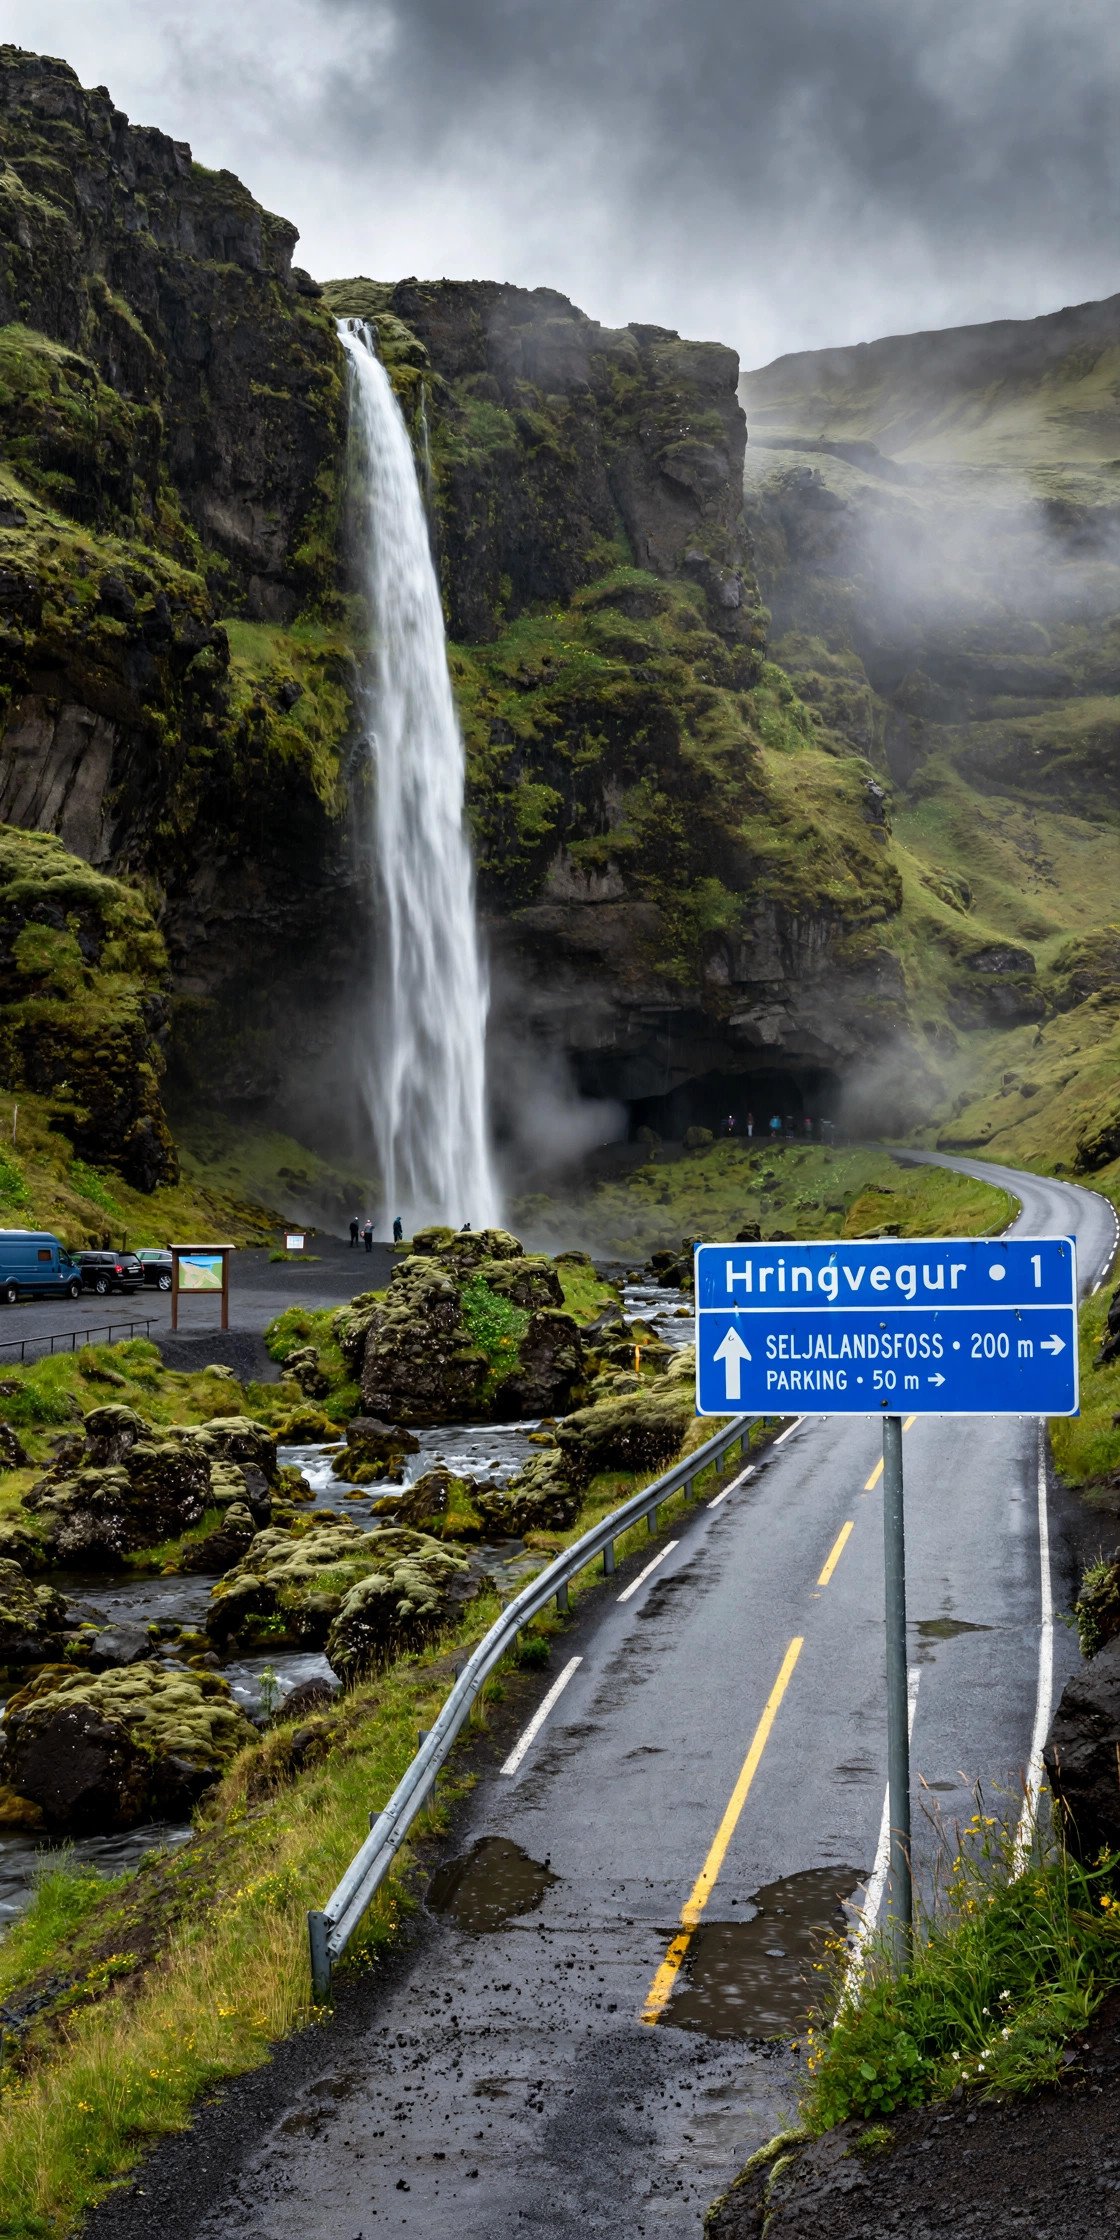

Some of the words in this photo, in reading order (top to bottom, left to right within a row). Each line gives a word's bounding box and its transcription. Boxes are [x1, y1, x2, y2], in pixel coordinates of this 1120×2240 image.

[726, 1258, 966, 1301] Hringvegur
[1030, 1254, 1042, 1288] 1
[766, 1333, 944, 1359] SELJALANDSFOSS
[971, 1332, 1010, 1358] 200
[1017, 1339, 1034, 1358] m
[766, 1370, 848, 1390] PARKING
[873, 1370, 897, 1390] 50
[904, 1375, 919, 1390] m
